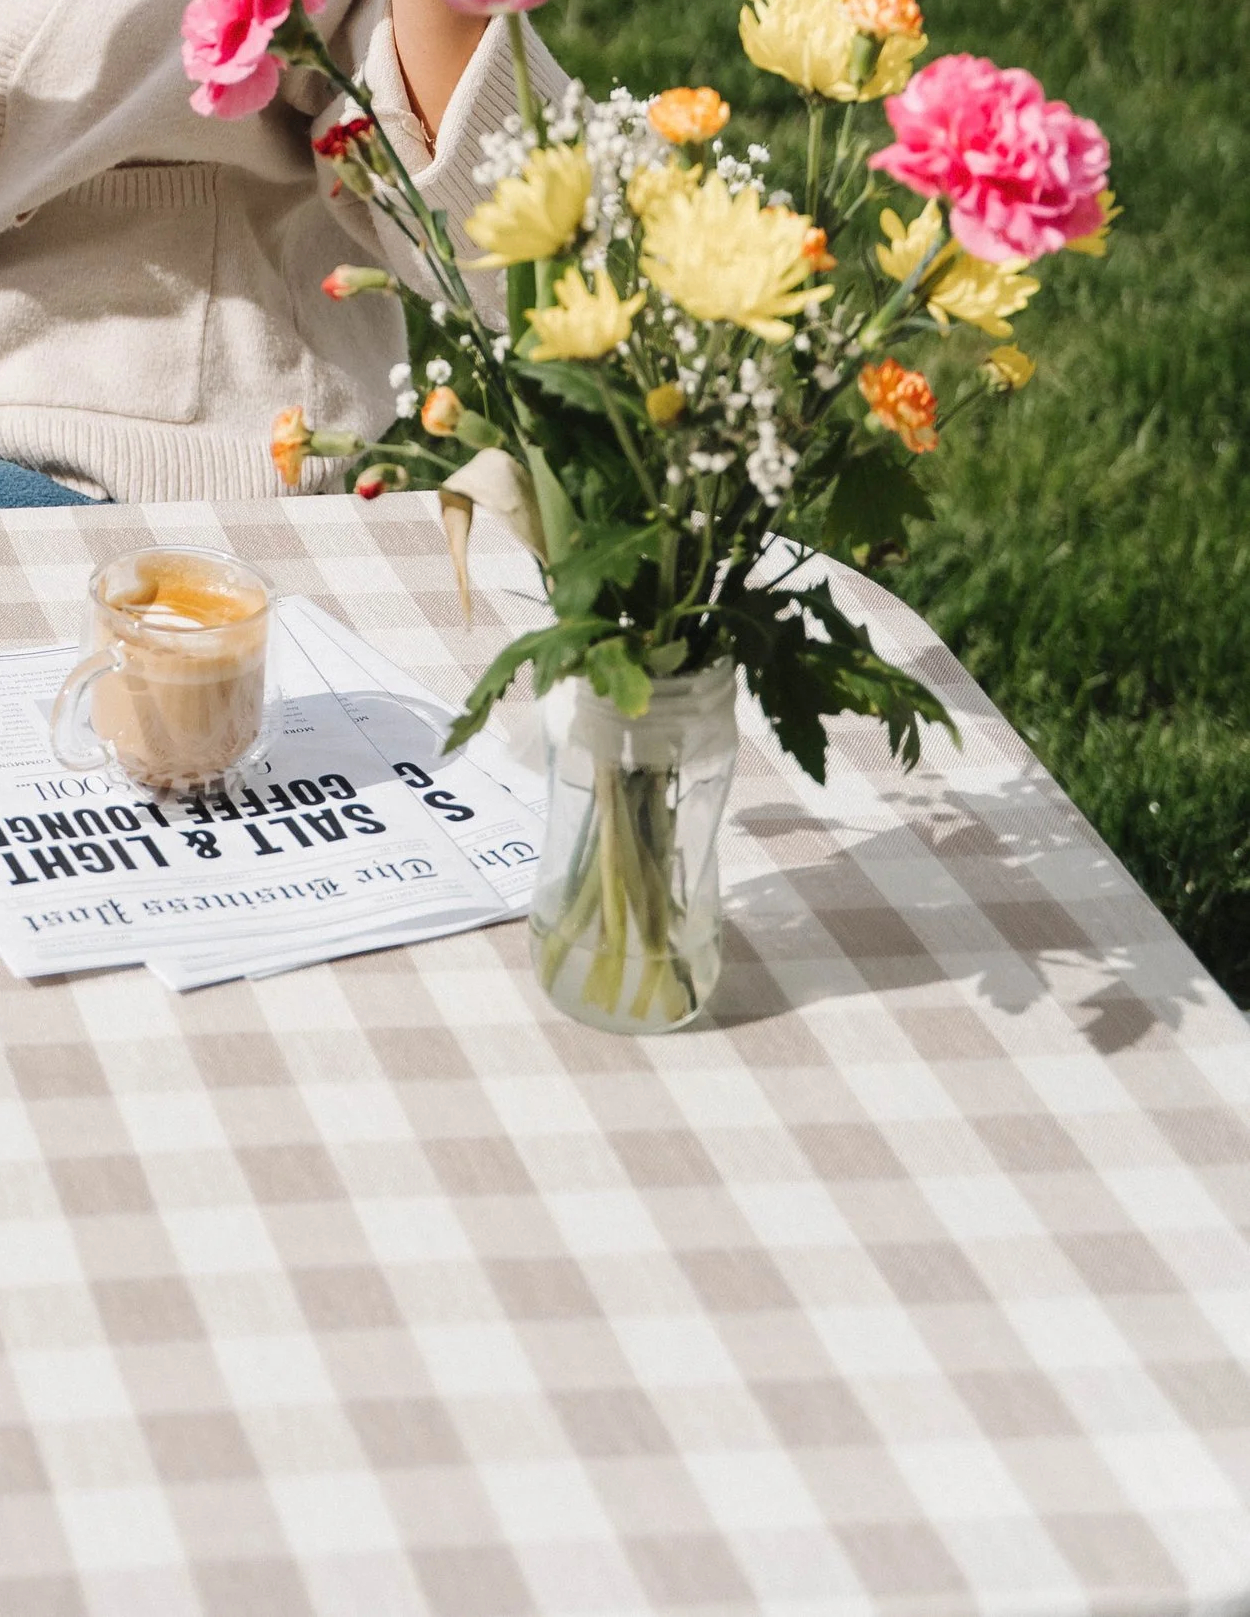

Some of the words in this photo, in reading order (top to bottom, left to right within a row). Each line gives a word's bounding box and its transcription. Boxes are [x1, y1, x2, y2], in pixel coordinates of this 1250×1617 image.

[178, 829, 223, 859] &
[243, 803, 387, 856] SALT
[0, 834, 171, 886] LIGHT
[354, 858, 438, 884] The
[23, 896, 134, 933] Post
[141, 876, 348, 915] Business
